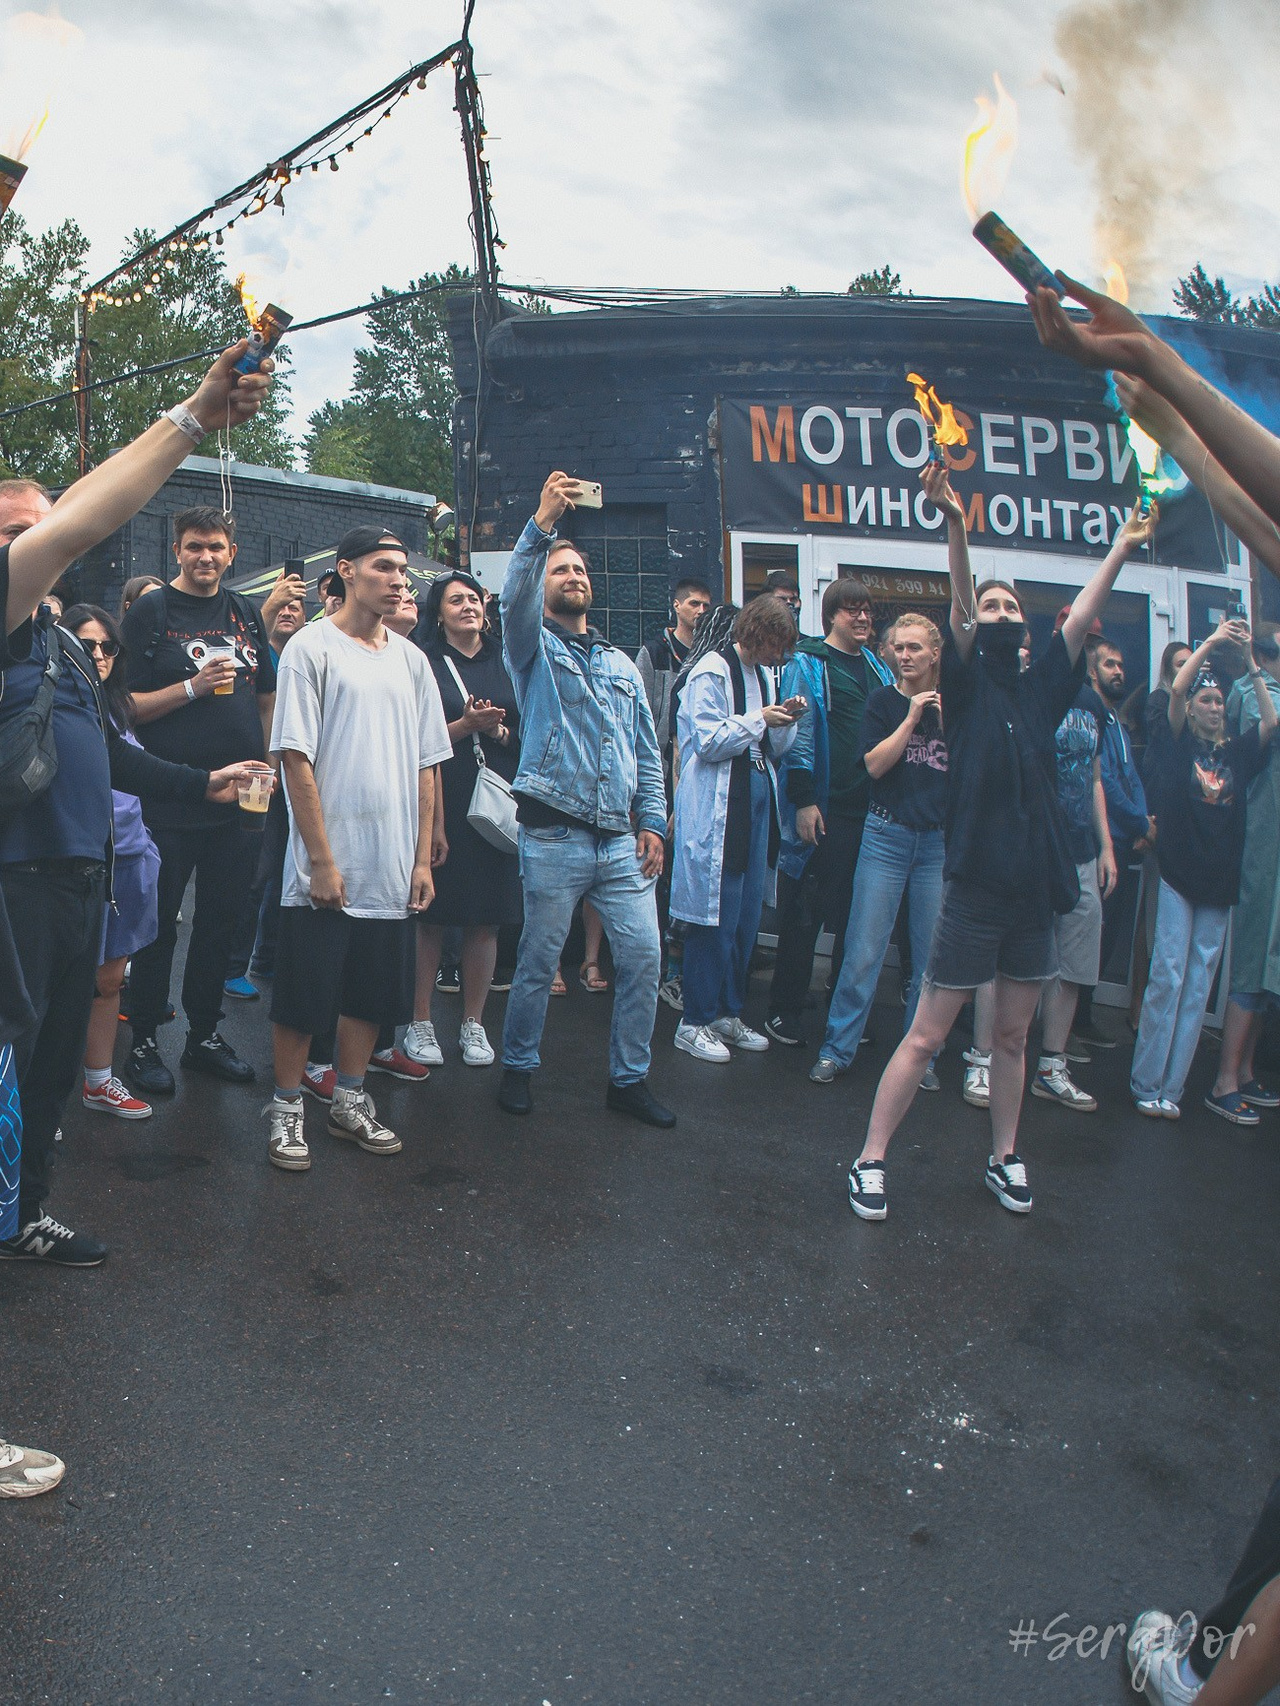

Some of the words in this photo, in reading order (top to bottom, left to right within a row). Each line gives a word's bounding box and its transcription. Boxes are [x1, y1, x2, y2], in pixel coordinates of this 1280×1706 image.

[749, 405, 1190, 491] МОТОСЕРВИ
[862, 573, 888, 590] 921
[24, 1235, 56, 1257] N
